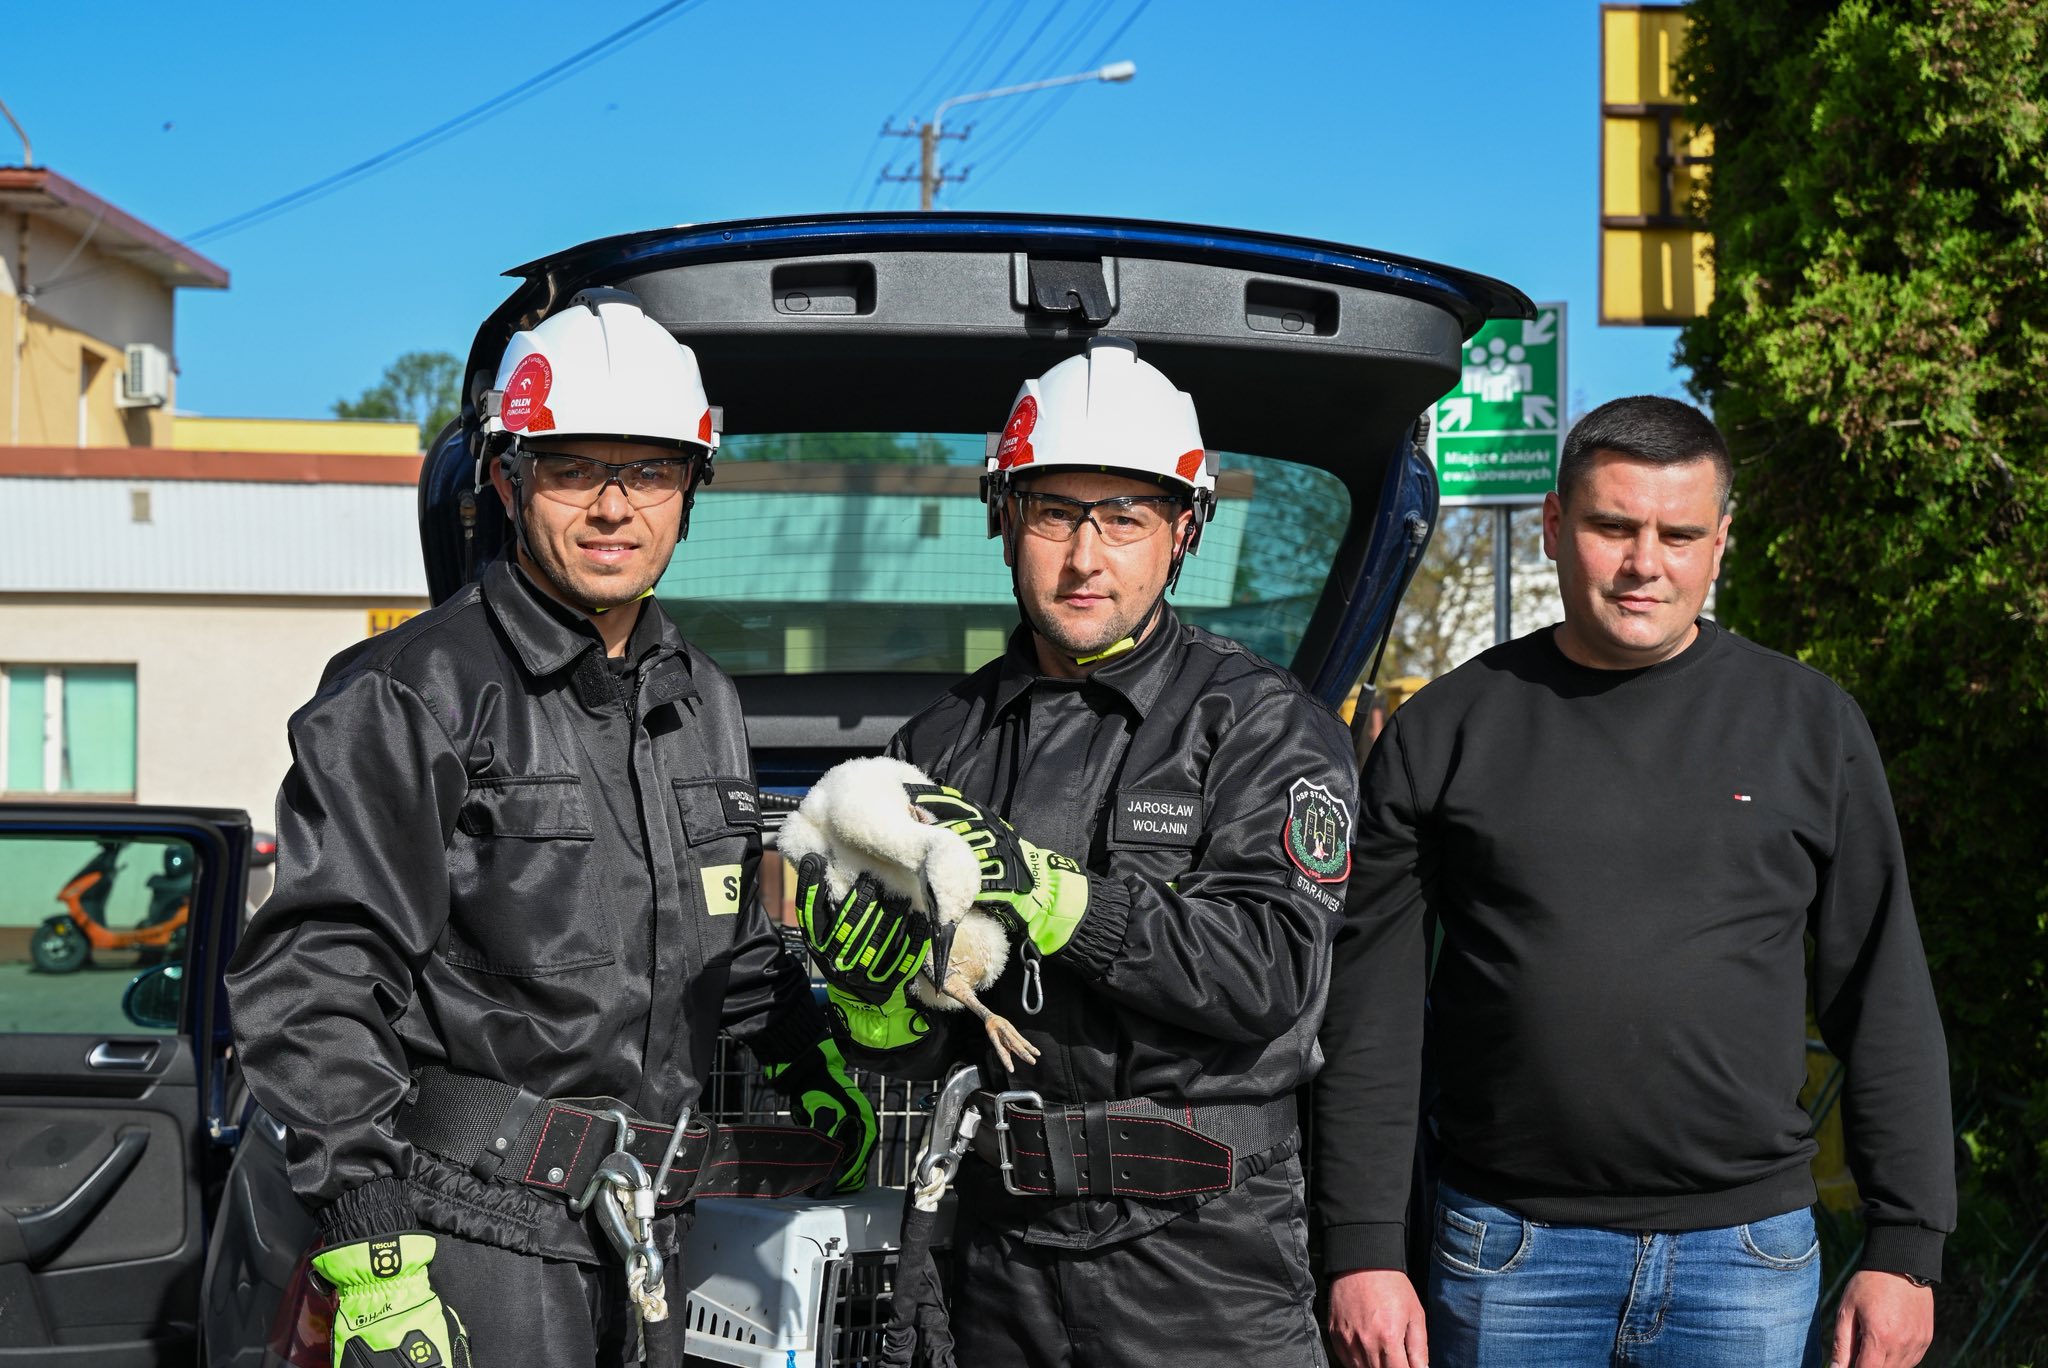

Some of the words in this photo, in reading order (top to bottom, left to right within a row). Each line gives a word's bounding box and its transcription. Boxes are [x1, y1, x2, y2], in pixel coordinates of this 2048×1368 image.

[510, 398, 531, 408] ORLEN
[1295, 790, 1309, 802] OSP
[1309, 790, 1331, 806] STARA
[1127, 800, 1194, 817] JAROSŁAW
[1132, 819, 1188, 835] WOLANIN
[371, 1240, 398, 1250] rescue
